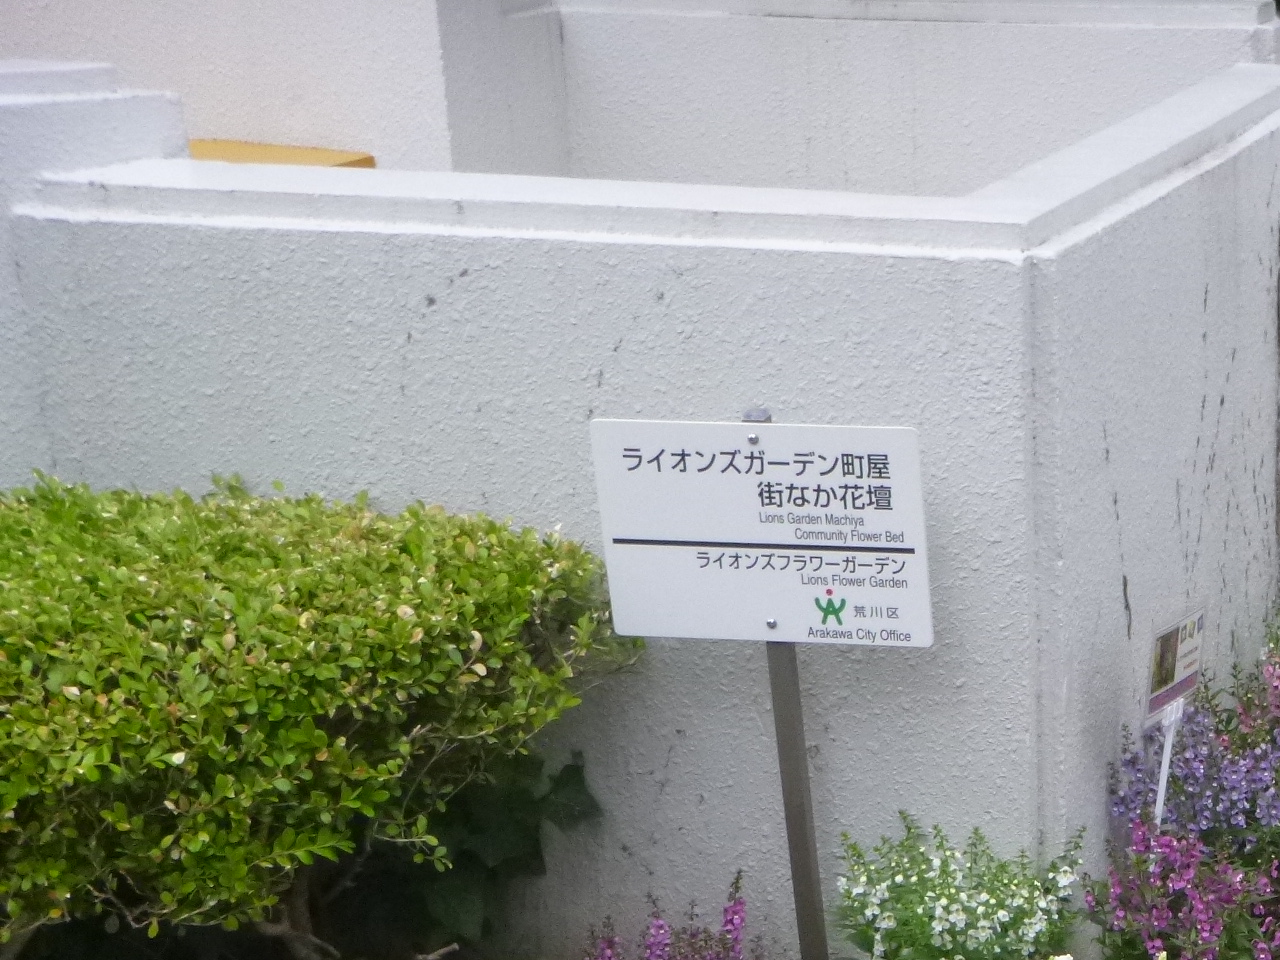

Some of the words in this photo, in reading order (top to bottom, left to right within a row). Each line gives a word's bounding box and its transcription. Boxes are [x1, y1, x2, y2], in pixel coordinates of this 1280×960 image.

[622, 448, 891, 480] ライオンズガーデン町屋
[757, 481, 893, 511] 街なか花壇
[759, 512, 785, 525] Lions
[787, 513, 822, 526] Garden
[825, 514, 864, 528] Machiya
[794, 528, 848, 544] Community
[851, 530, 883, 543] Flower
[885, 531, 904, 543] Bed
[696, 552, 906, 575] ライオンズフラワーガーデン
[801, 573, 829, 586] Lions
[832, 574, 866, 588] Flower
[869, 576, 908, 589] Garden
[853, 605, 899, 619] 荒川区
[807, 627, 853, 640] Arakawa
[856, 628, 877, 643] City
[879, 629, 911, 642] Office
